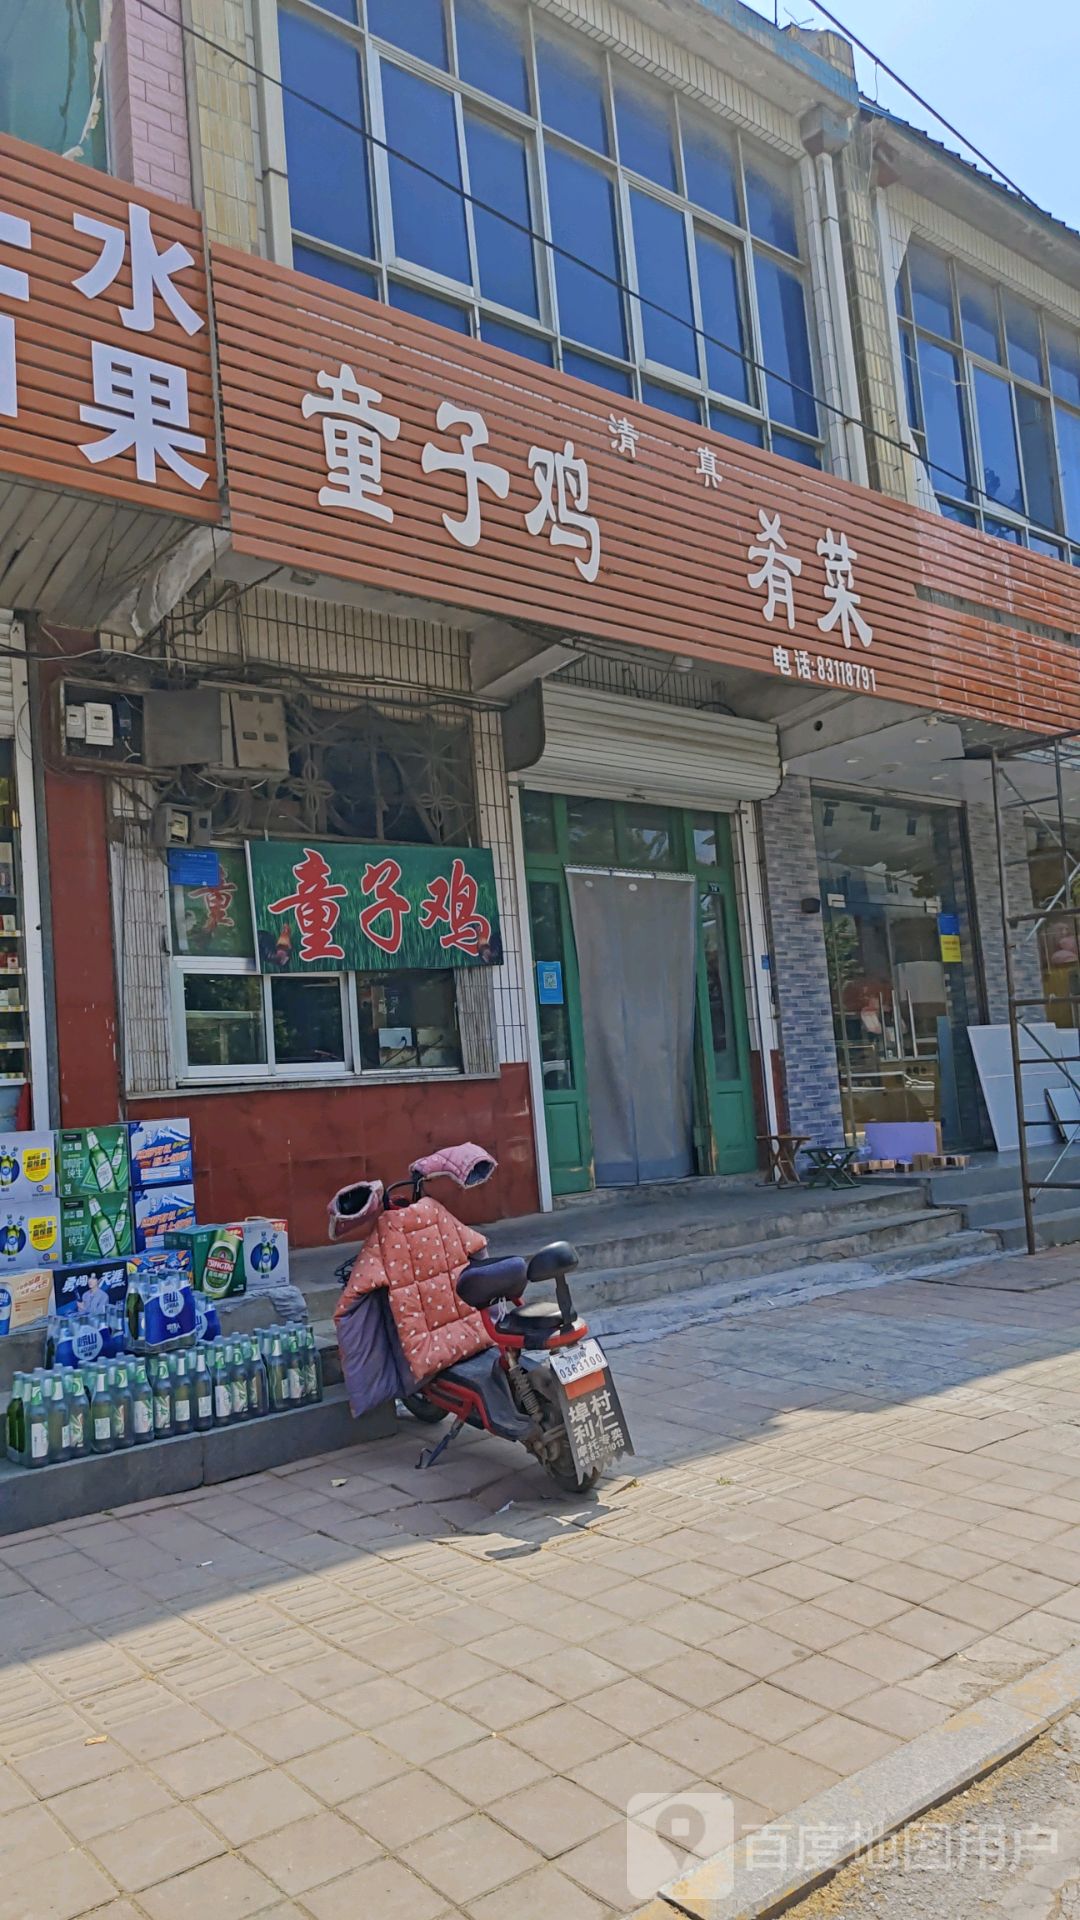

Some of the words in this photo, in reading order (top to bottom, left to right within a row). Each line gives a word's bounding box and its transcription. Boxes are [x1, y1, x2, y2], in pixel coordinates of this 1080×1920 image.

[72, 202, 210, 491] 水果
[302, 364, 601, 583] 童子鸡
[607, 413, 723, 488] 清真
[748, 509, 873, 648] 肴菜
[268, 848, 491, 962] 童子鸡
[560, 1353, 603, 1379] 0363100
[568, 1389, 611, 1423] 埠村
[573, 1411, 619, 1445] 利仁
